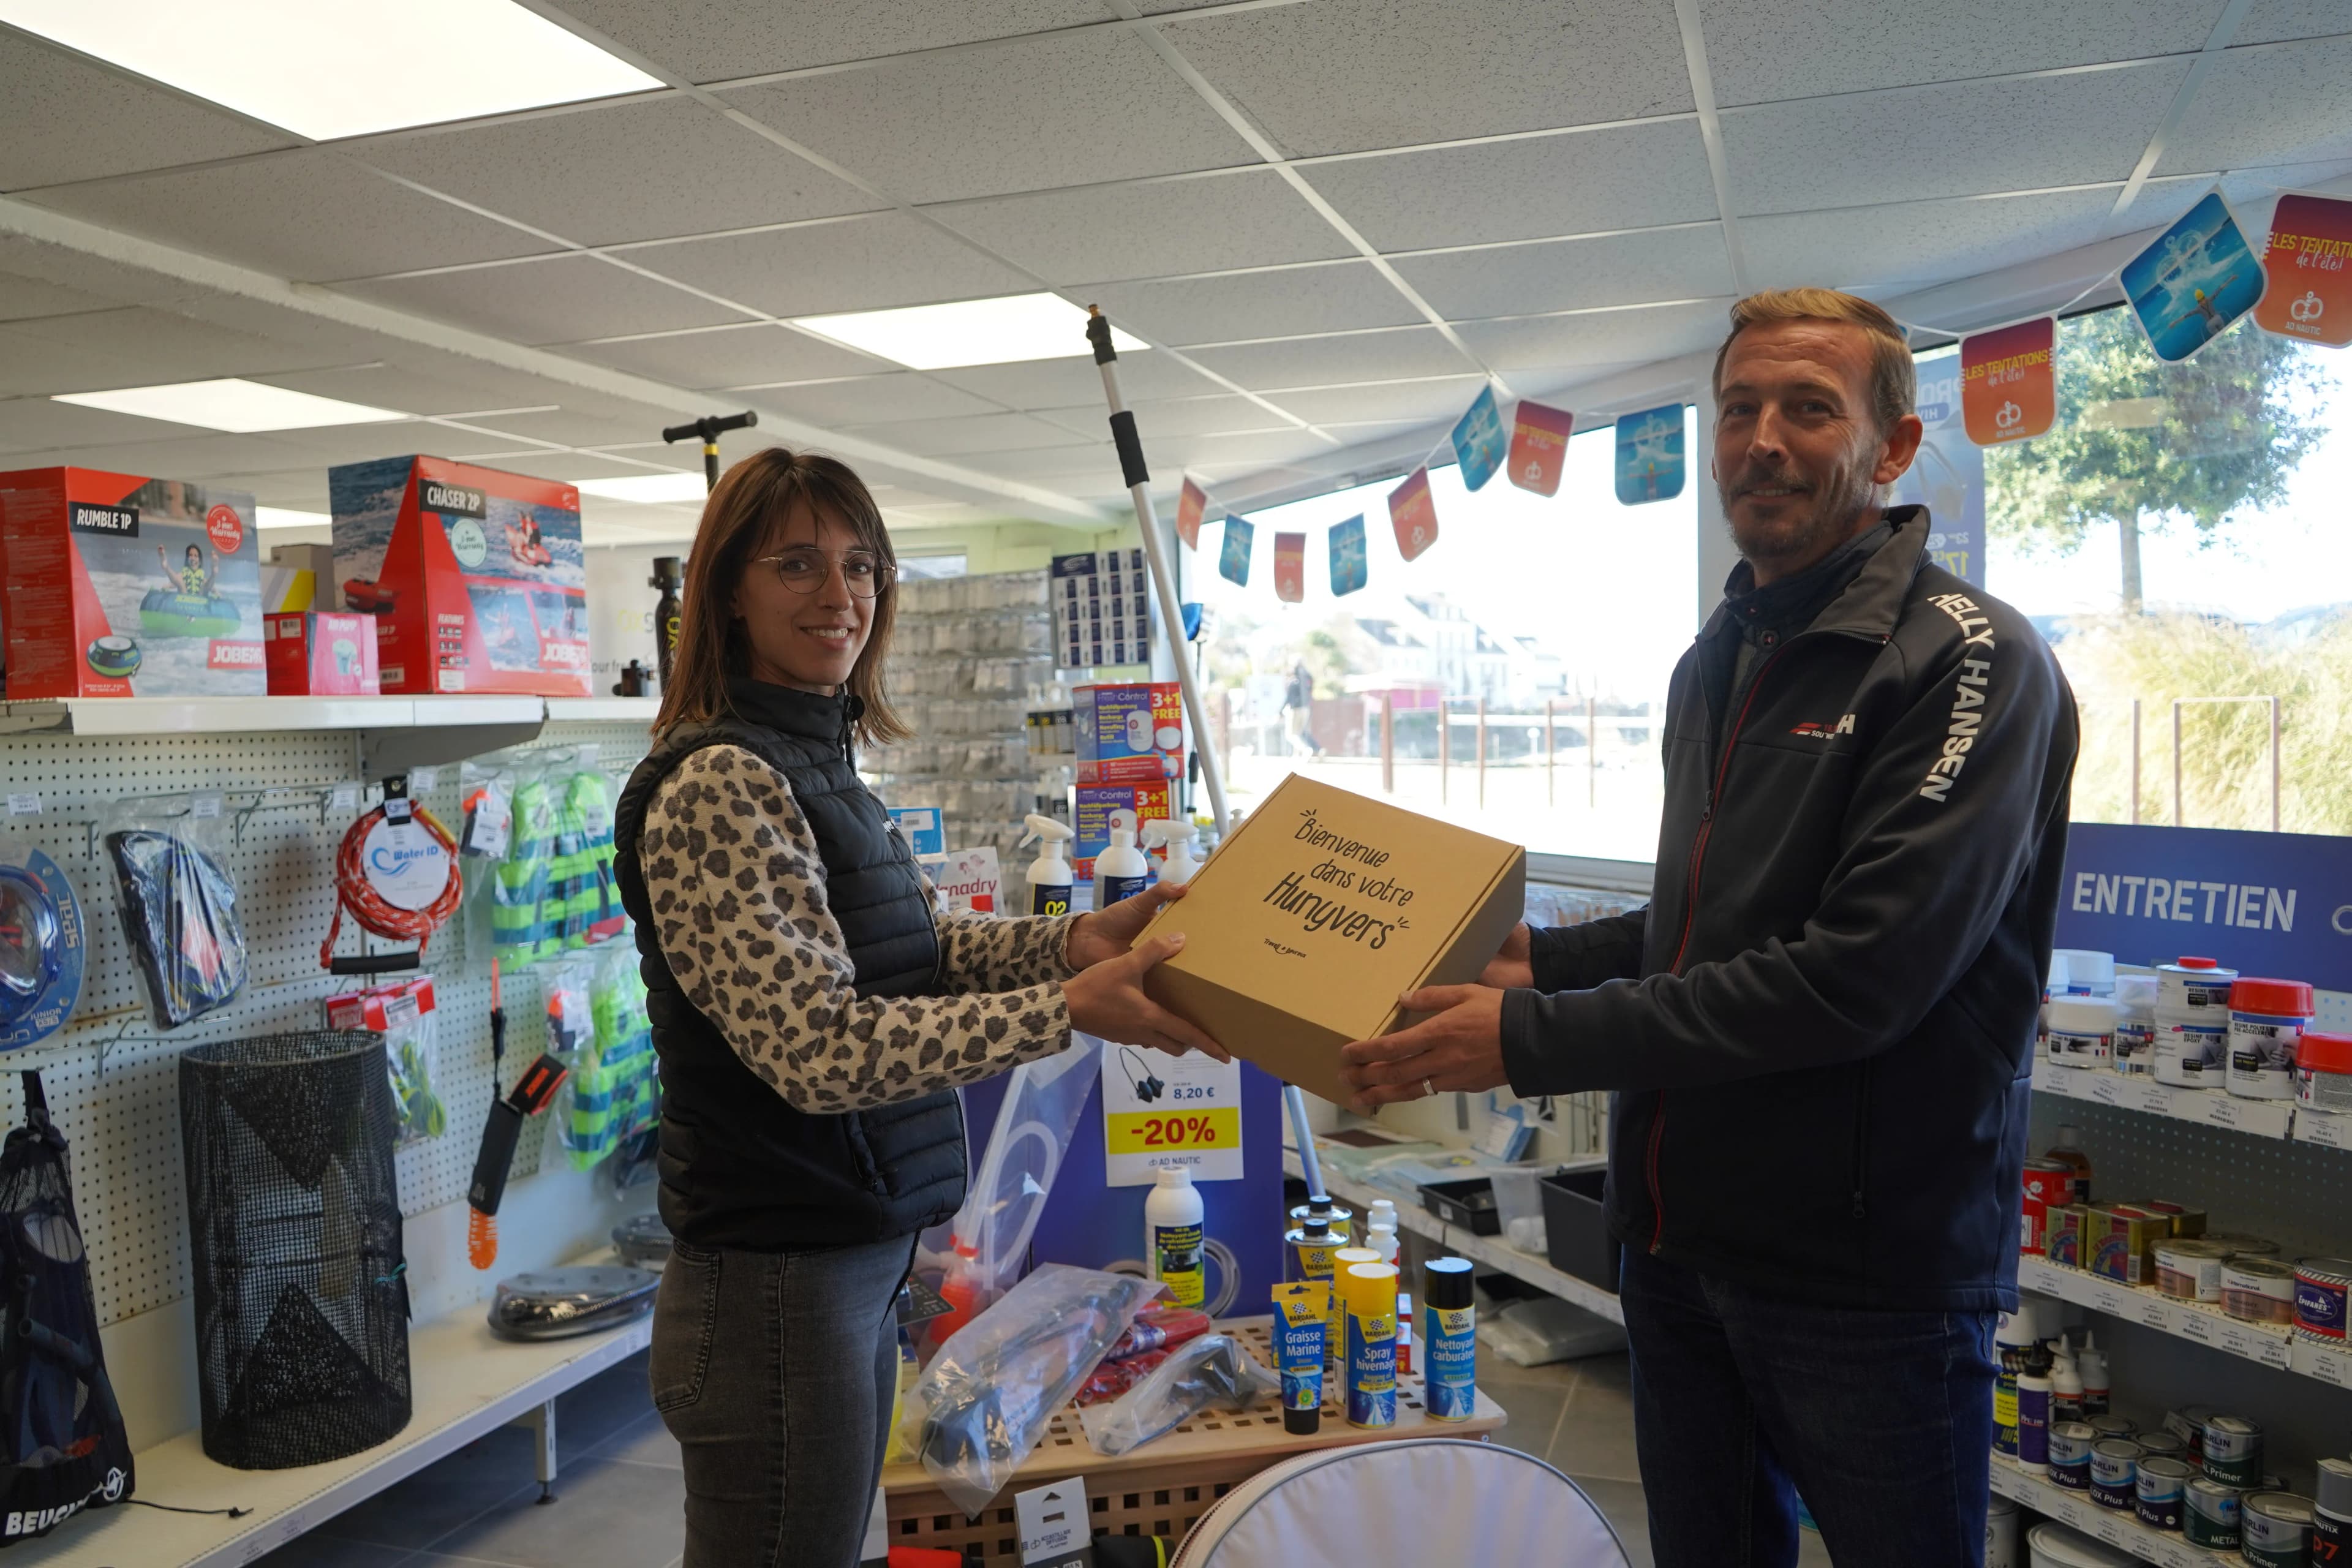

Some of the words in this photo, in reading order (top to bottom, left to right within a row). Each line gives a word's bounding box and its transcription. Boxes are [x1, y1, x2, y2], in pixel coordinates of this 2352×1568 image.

[2273, 233, 2297, 250] LES
[2296, 248, 2308, 268] de
[2296, 323, 2321, 335] NAUTIC
[1966, 364, 1985, 380] LES
[1986, 349, 2049, 374] TENTATIONS
[427, 486, 466, 510] CHASER
[467, 492, 480, 511] 2P
[77, 508, 118, 529] RUMBLE
[120, 513, 132, 530] 1P
[1927, 593, 1995, 651] HELLY
[1118, 692, 1148, 701] Control
[1152, 692, 1181, 707] 3+1
[1152, 708, 1181, 719] FREE
[1919, 658, 1991, 802] HANSEN
[1099, 791, 1132, 800] Control
[1137, 790, 1167, 806] 3+1
[1137, 807, 1168, 818] FREE
[1294, 818, 1390, 868] Bienvenue
[394, 848, 424, 861] Water
[427, 846, 438, 856] ID
[1310, 859, 1355, 888] dans
[1358, 877, 1414, 907] votre
[1045, 901, 1066, 916] 02
[2072, 872, 2297, 932] ENTRETIEN
[31, 1008, 61, 1020] JUNIOR
[1174, 1088, 1202, 1101] 8,20
[1206, 1087, 1215, 1098] €
[1131, 1117, 1216, 1145] -20%
[1172, 1156, 1200, 1165] NAUTIC
[1289, 1313, 1317, 1322] BARDAHL
[1286, 1330, 1321, 1344] Graisse
[1287, 1343, 1321, 1357] Marine
[1365, 1348, 1392, 1362] Spray
[2048, 1439, 2073, 1453] ARLIN
[2059, 1472, 2078, 1484] Plus
[2136, 1474, 2155, 1489] RLIN
[2210, 1466, 2242, 1482] Primer
[2104, 1493, 2123, 1506] Plus
[2142, 1509, 2159, 1521] Plus
[2211, 1535, 2239, 1545] METAL
[2249, 1551, 2277, 1568] Primer
